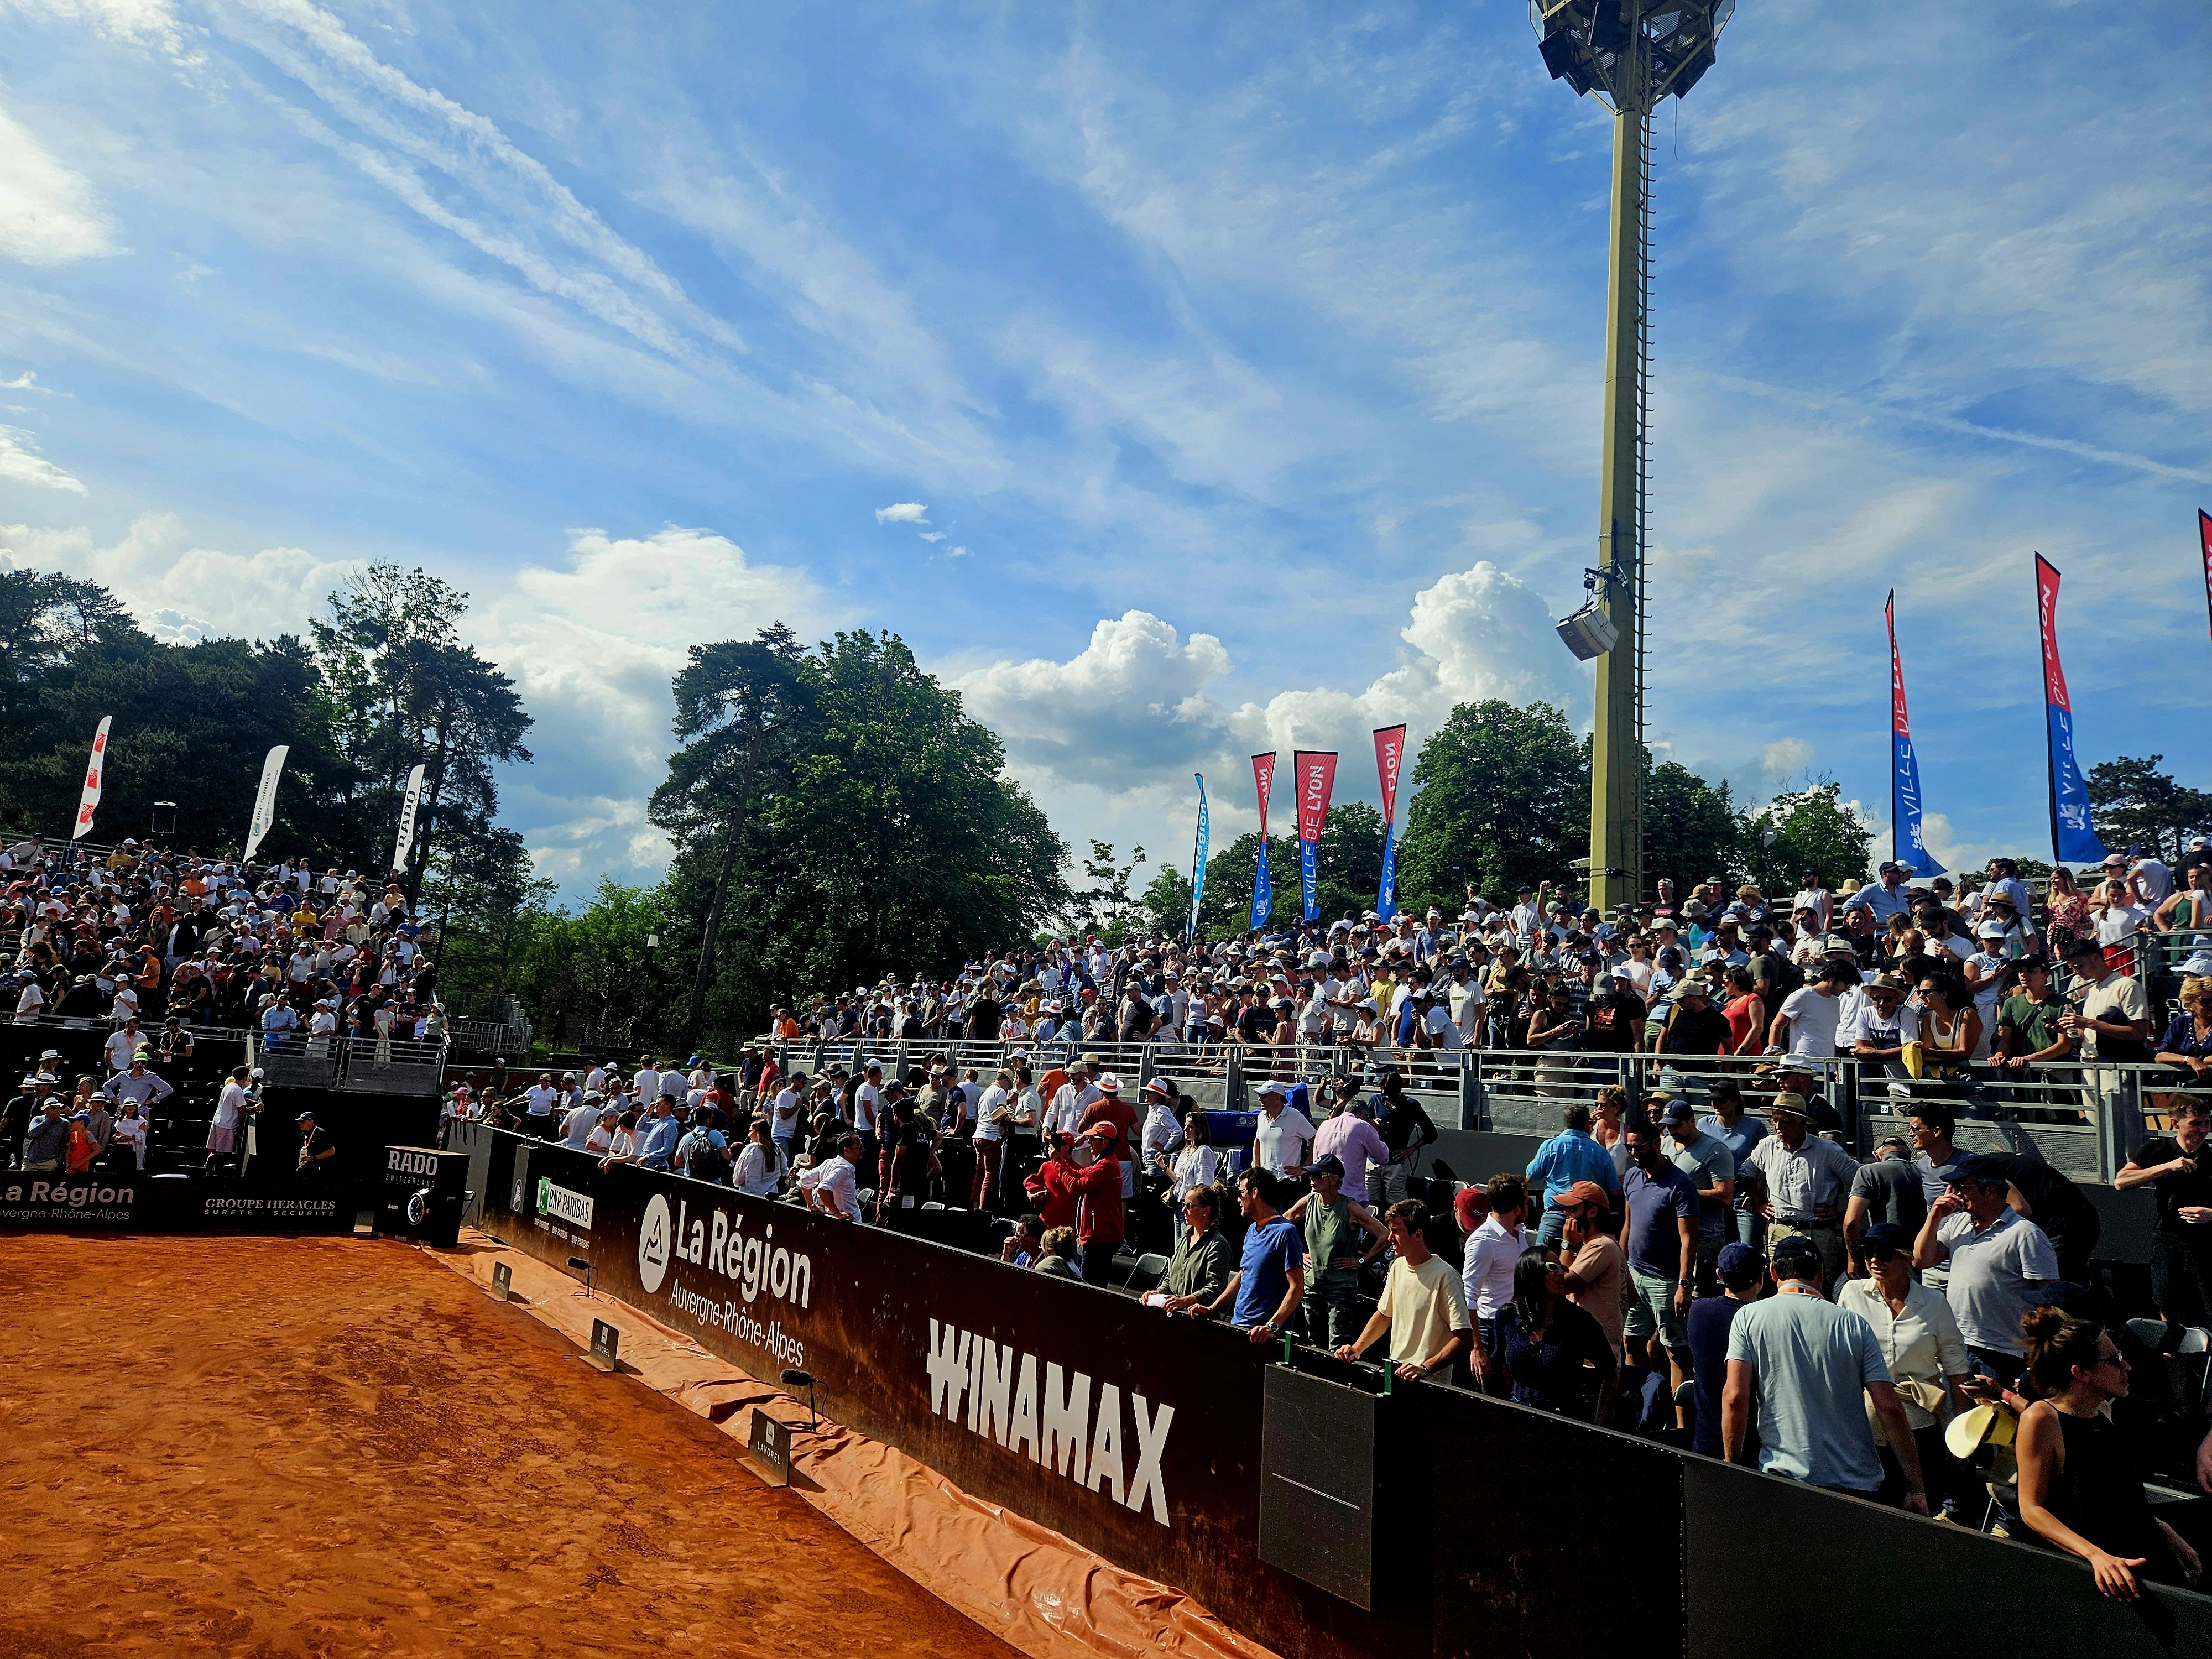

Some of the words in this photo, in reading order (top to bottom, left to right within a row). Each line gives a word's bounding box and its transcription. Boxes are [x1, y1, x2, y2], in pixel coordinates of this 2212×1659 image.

[1307, 765, 1324, 811] LYON
[398, 790, 415, 849] RADO
[1306, 815, 1320, 840] DE
[1305, 844, 1316, 894] VILLE
[387, 1150, 438, 1176] RADO
[0, 1186, 22, 1201] a
[30, 1181, 134, 1207] Région
[385, 1173, 435, 1188] SWITZERLAND
[0, 1208, 130, 1220] vergne-Rhône-Alpes
[205, 1199, 264, 1208] GROUPE
[267, 1200, 336, 1210] HERACLES
[549, 1188, 562, 1211] BNP
[562, 1193, 589, 1223] PARIBAS
[676, 1200, 705, 1265] La
[708, 1210, 811, 1308] Région
[669, 1278, 804, 1368] Auvergne-Rhône-Alpes
[927, 1318, 1175, 1528] WINAMAX
[757, 1441, 780, 1464] LAVOREL
